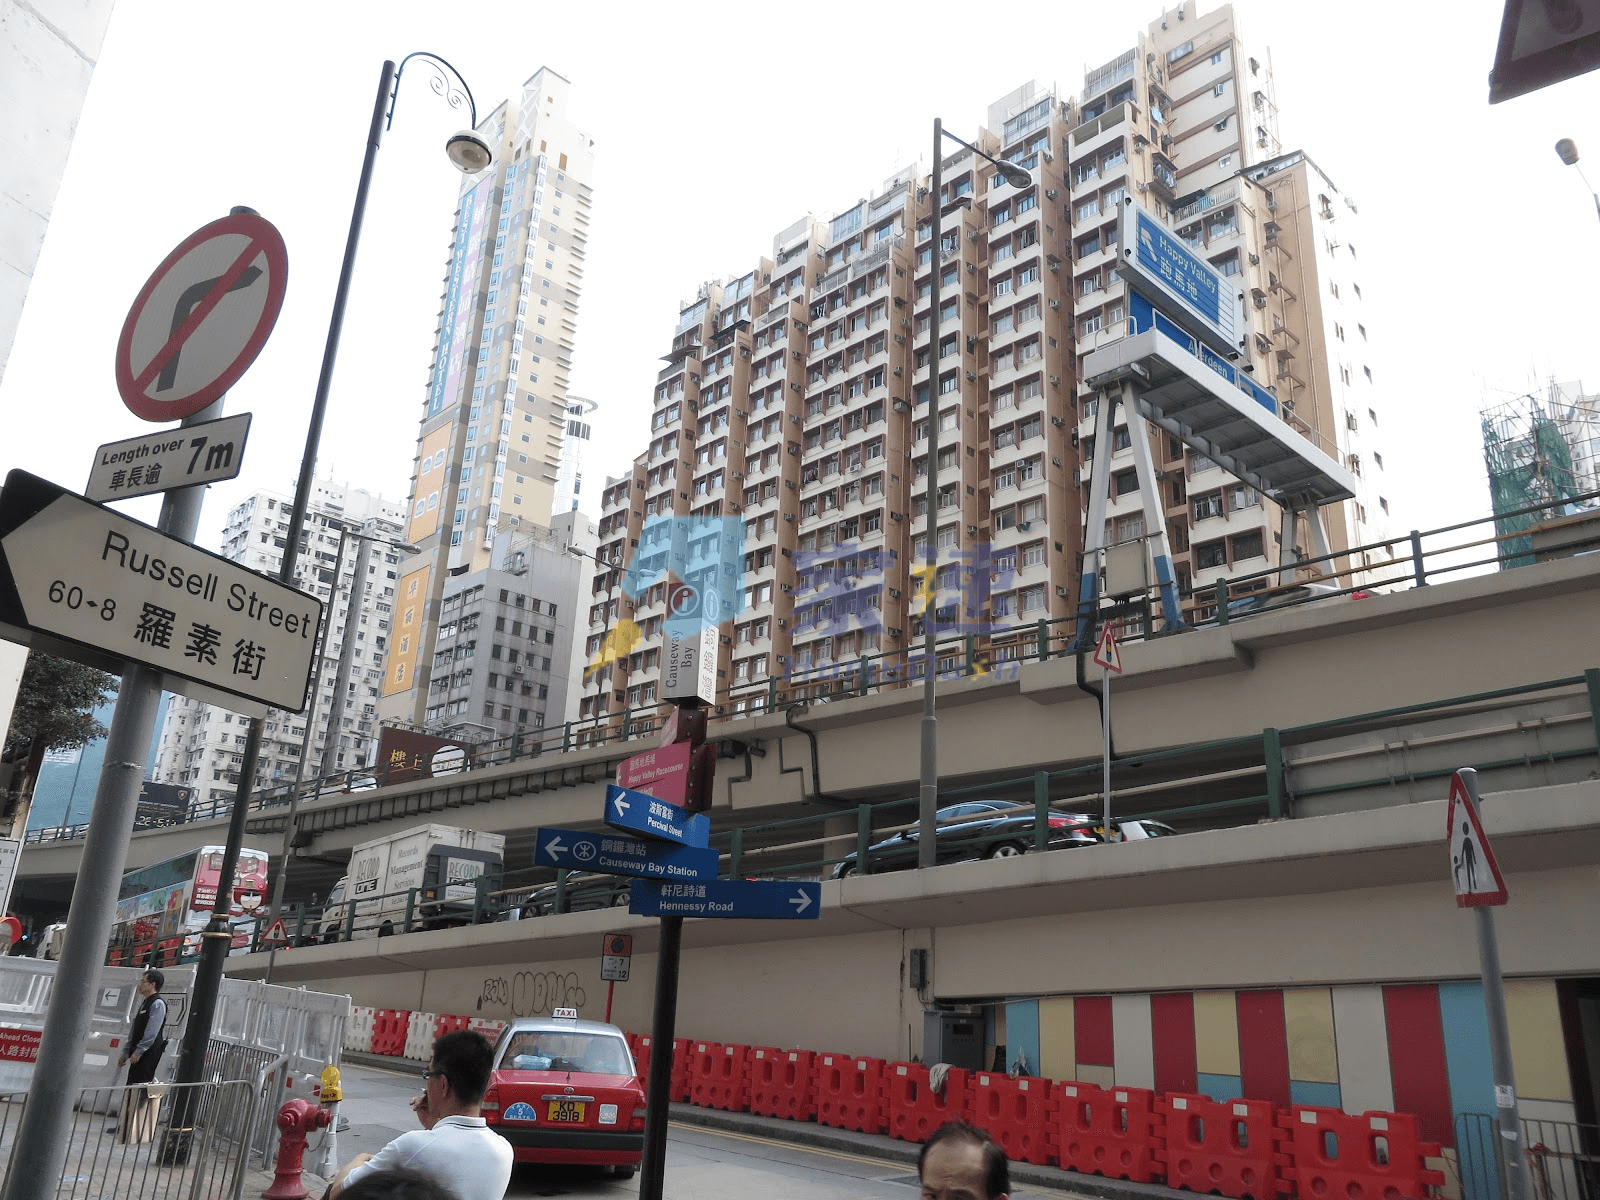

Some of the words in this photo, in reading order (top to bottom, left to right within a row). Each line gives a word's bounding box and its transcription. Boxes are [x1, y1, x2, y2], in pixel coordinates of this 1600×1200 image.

[460, 195, 473, 245] BEST
[1160, 236, 1189, 270] Happy
[1190, 261, 1216, 293] Valley
[1160, 256, 1198, 301] 跑馬地
[445, 250, 464, 340] WESTERN
[1188, 340, 1228, 378] Aerdeen
[432, 340, 448, 411] HOTEL
[102, 444, 149, 466] Length
[152, 439, 186, 455] over
[187, 436, 234, 475] 7m
[108, 462, 162, 491] 車長逾
[102, 530, 219, 602] Russell
[227, 583, 311, 639] Street
[134, 602, 267, 681] 羅素街
[666, 630, 683, 688] Causeway
[681, 647, 696, 668] Bay
[628, 774, 642, 784] Happy
[642, 771, 656, 780] Valley
[656, 763, 684, 776] Racecourse
[647, 816, 669, 832] Percival
[669, 824, 683, 838] Street
[398, 845, 418, 859] Records
[601, 839, 647, 856] 銅鑼灣站
[356, 856, 380, 881] RECORD
[390, 861, 423, 876] Management
[448, 862, 480, 879] RECORD
[599, 856, 646, 872] Causeway
[648, 862, 665, 875] Bay
[667, 865, 698, 877] Station
[394, 878, 415, 890] Services
[661, 884, 707, 898] 軒尼詩道
[659, 901, 706, 912] Hennessy
[708, 901, 734, 911] Road
[618, 970, 627, 978] 12
[552, 1111, 579, 1120] 3918
[560, 1101, 575, 1111] KD
